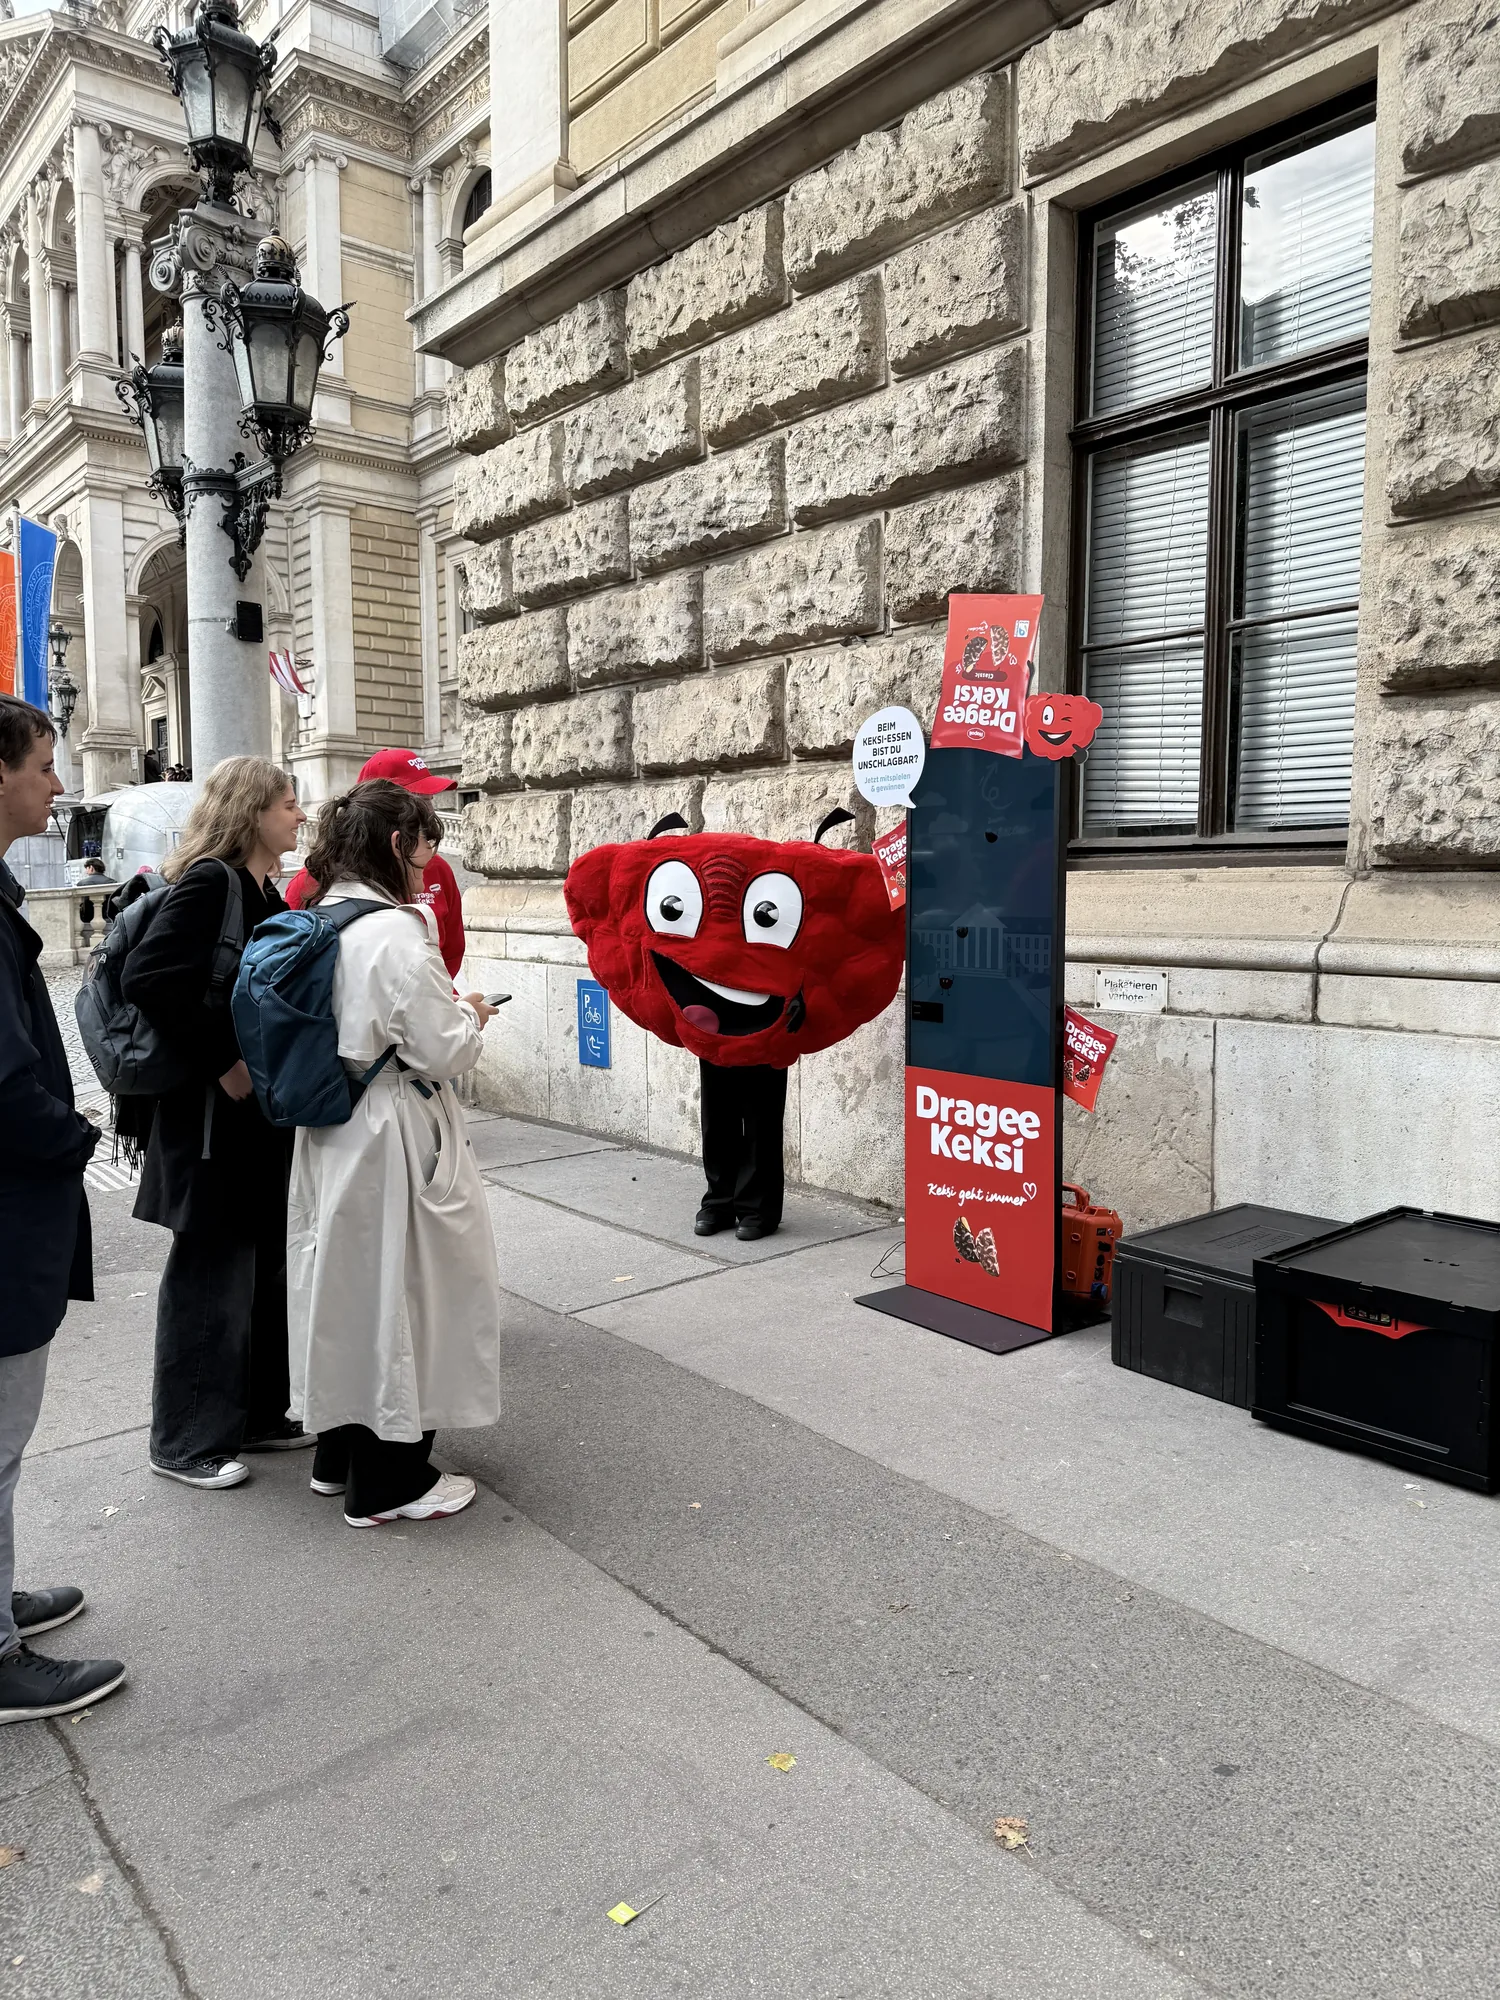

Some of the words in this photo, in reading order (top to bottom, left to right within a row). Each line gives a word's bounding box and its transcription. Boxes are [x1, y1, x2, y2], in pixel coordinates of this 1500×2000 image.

[954, 685, 1010, 709] Keksi
[877, 722, 896, 732] BEIM
[943, 703, 1016, 732] Dragee
[862, 731, 912, 746] KEKSI-ESSEN
[872, 746, 889, 756] BIST
[890, 745, 901, 754] DU
[858, 755, 919, 769] UNSCHLAGBAR?
[864, 775, 878, 784] Jetzt
[880, 773, 911, 783] mitspielen
[876, 783, 905, 793] gewinnen
[584, 994, 590, 1008] P
[1065, 1020, 1107, 1053] Dragee
[1067, 1035, 1100, 1062] Keksi
[916, 1085, 1041, 1139] Dragee
[930, 1122, 1024, 1173] Keksi
[927, 1182, 956, 1198] Keksi
[958, 1187, 984, 1206] geht
[985, 1191, 1027, 1206] immer
